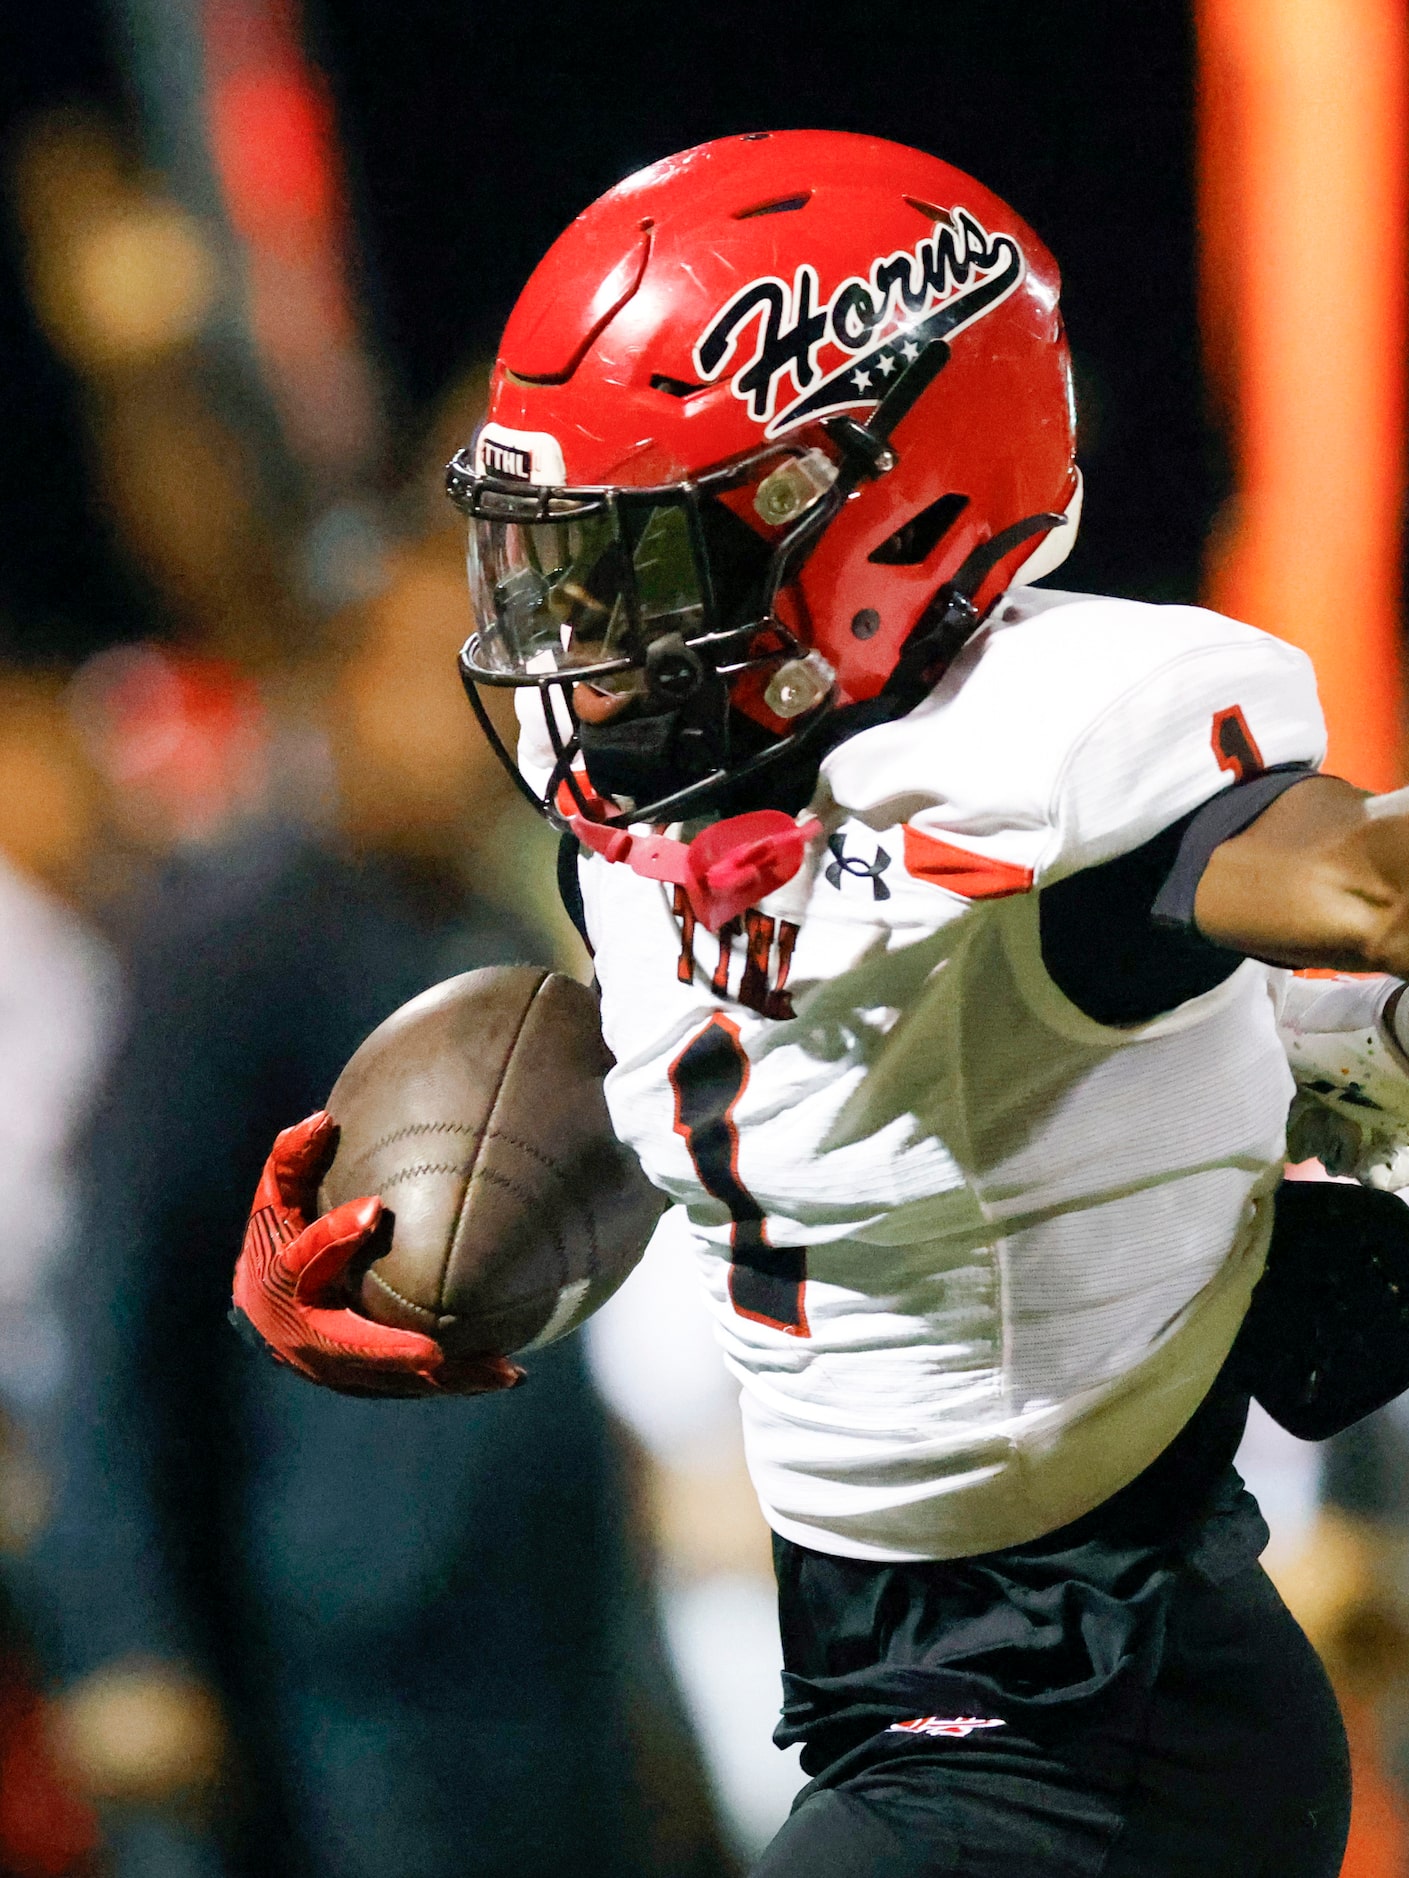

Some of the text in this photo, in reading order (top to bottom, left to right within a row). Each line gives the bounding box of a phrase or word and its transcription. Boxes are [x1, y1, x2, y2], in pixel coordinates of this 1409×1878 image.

[692, 206, 1026, 422] Horns
[1211, 704, 1265, 786] 1
[667, 1011, 812, 1339] 1
